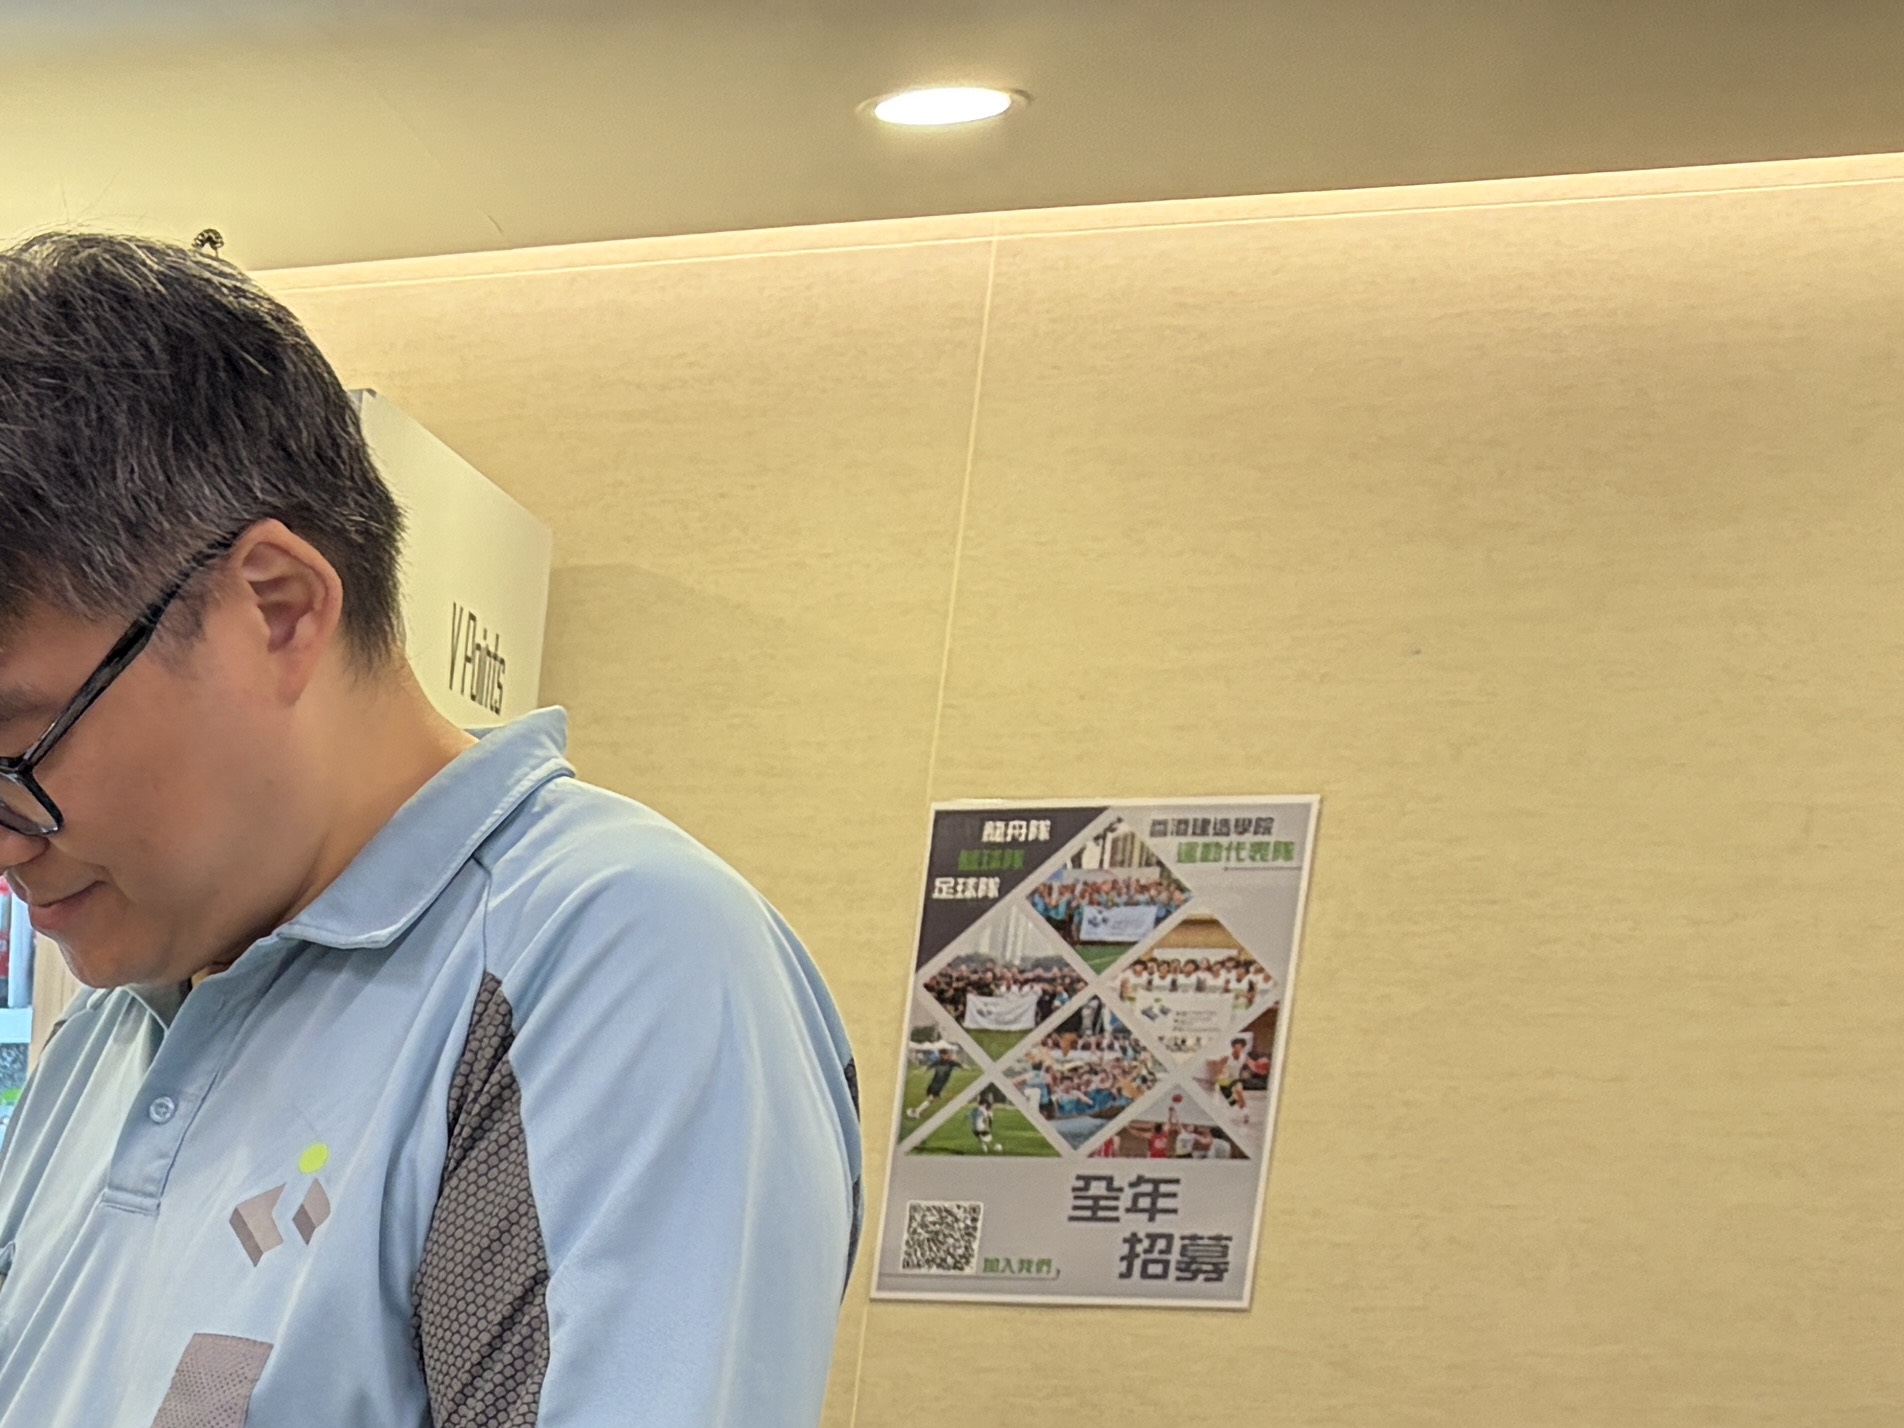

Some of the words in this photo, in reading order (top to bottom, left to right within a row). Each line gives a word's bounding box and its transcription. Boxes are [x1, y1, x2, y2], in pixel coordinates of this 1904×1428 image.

[449, 601, 463, 691] V
[461, 611, 506, 716] Points
[1149, 817, 1275, 838] 香港建造學院
[932, 876, 1000, 899] 足球隊
[1067, 1173, 1182, 1223] 全年
[1118, 1232, 1233, 1283] 招募
